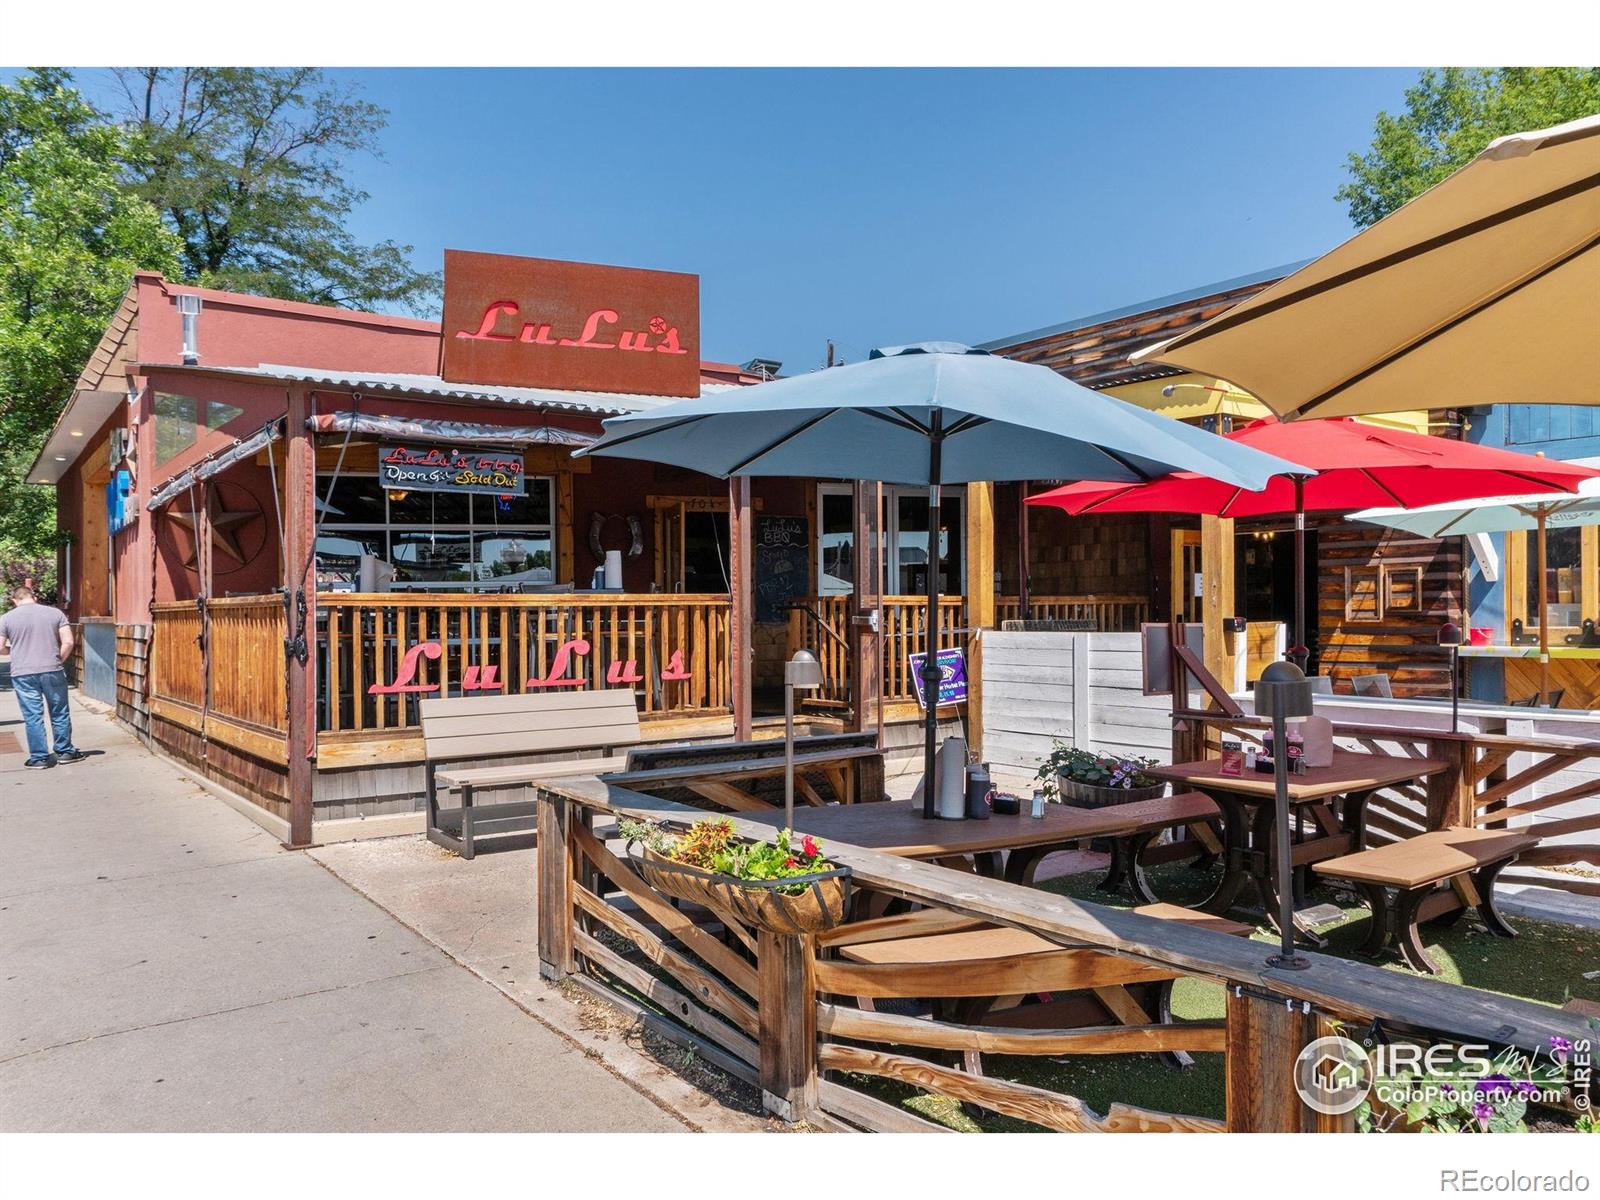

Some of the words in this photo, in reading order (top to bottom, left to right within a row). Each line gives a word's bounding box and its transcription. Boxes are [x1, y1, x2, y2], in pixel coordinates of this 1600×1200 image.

[456, 300, 688, 354] LuLu's
[386, 465, 428, 481] Open
[455, 470, 492, 484] Sold
[493, 472, 518, 487] Out
[764, 532, 791, 543] BBQ
